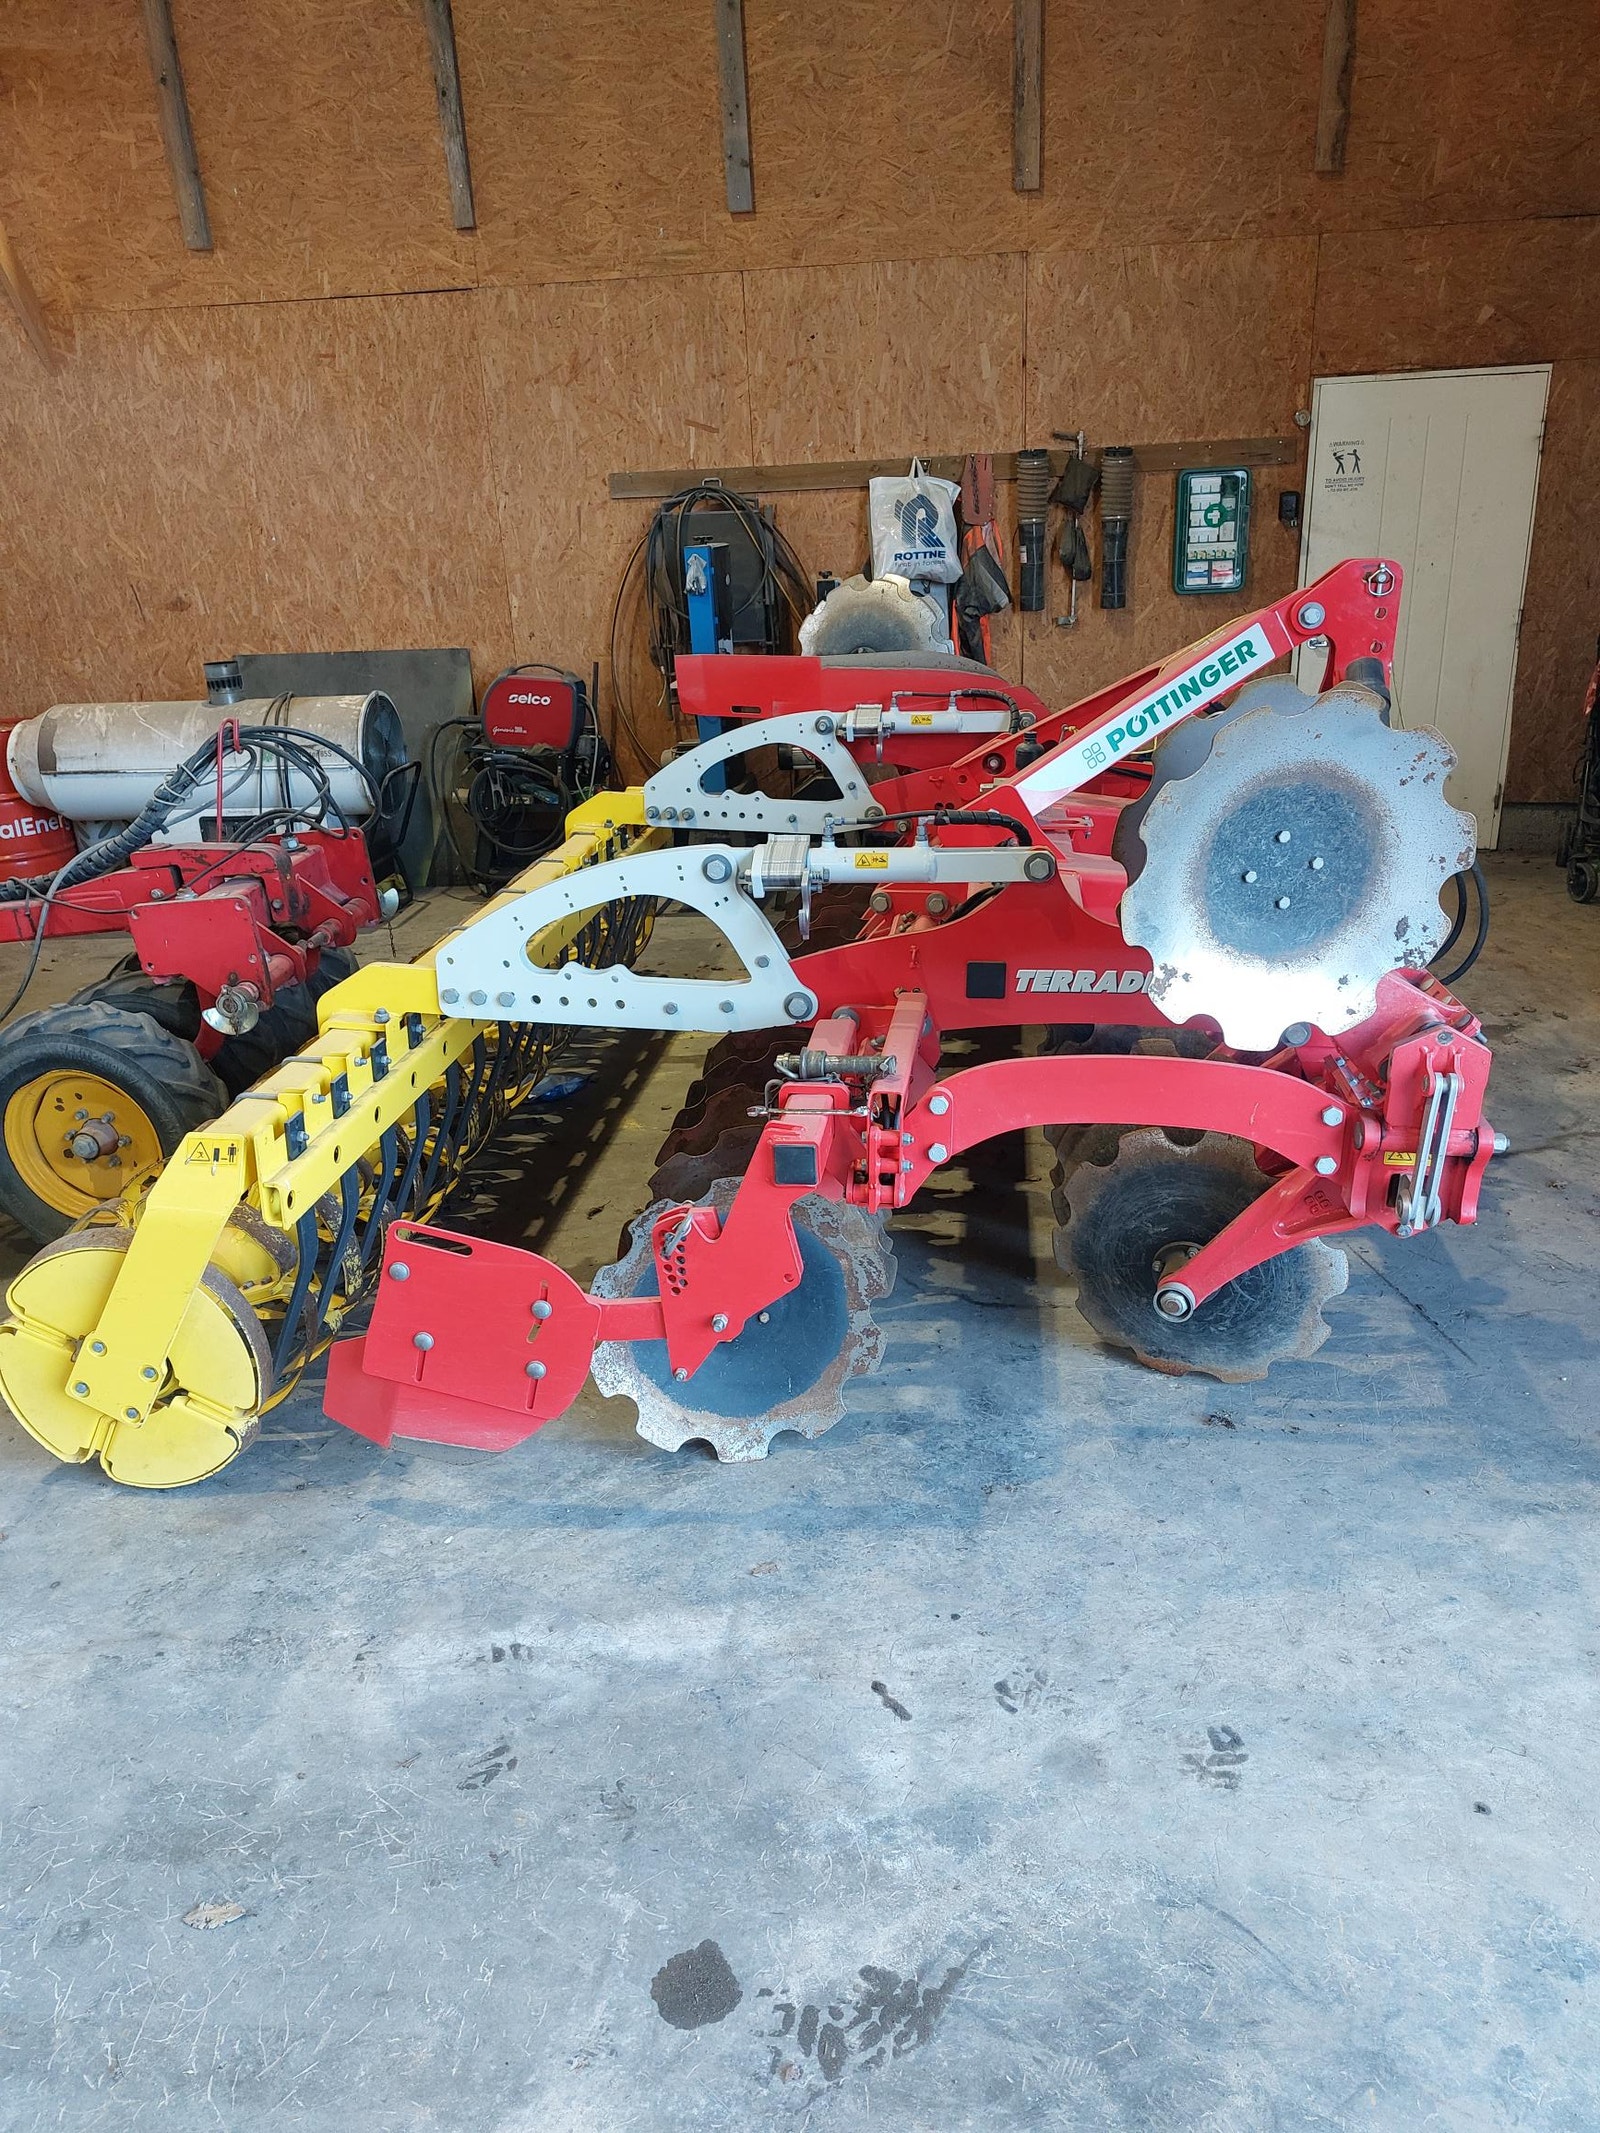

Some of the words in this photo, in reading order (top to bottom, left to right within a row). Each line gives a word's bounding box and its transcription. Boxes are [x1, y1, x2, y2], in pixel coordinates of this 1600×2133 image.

[894, 550, 947, 561] ROTTNE
[508, 692, 551, 705] selco
[1105, 639, 1258, 752] PÖTTINGER
